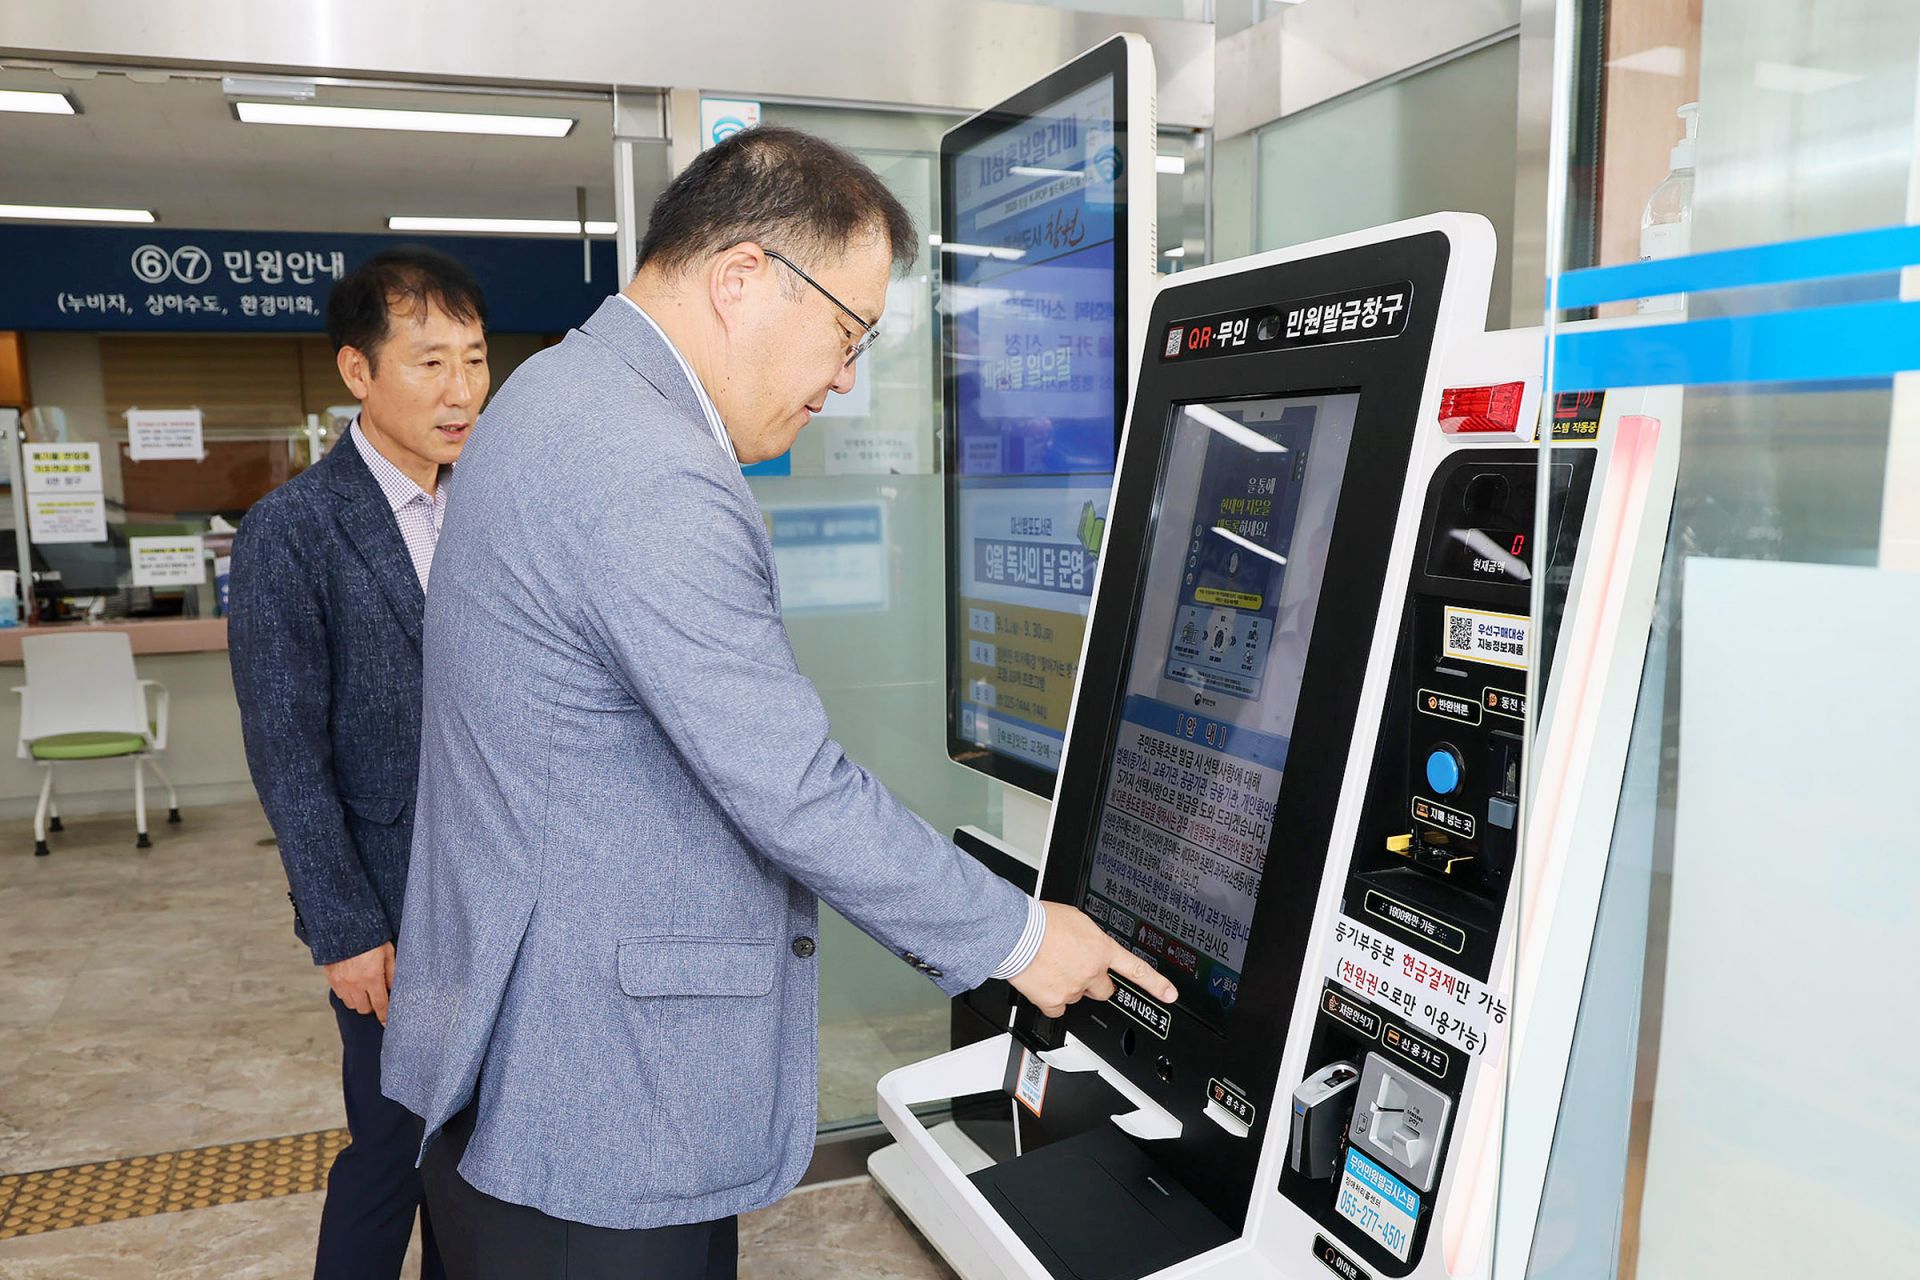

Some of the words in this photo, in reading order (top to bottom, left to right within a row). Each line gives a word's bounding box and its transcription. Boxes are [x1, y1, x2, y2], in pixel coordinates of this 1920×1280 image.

[224, 250, 345, 284] 민원안내
[58, 293, 133, 315] (누비자,
[145, 294, 228, 315] 상하수도,
[1286, 293, 1403, 337] 민원발급창구
[1572, 422, 1597, 433] 작동중
[1257, 476, 1275, 494] 통해
[1512, 535, 1524, 555] 0
[1007, 545, 1040, 585] 독서의
[1042, 548, 1055, 586] 달
[1059, 550, 1084, 590] 운영
[1473, 559, 1504, 573] 현재금액
[1477, 638, 1524, 656] 지능정보제품
[1478, 624, 1524, 641] 우선구매대상
[1438, 698, 1469, 716] 반환버튼
[1501, 696, 1518, 711] 동전
[1136, 735, 1178, 762] 주민등록초본
[1178, 748, 1194, 767] 발급
[1194, 753, 1202, 770] 시
[1202, 757, 1242, 785] 선택사항에
[1244, 771, 1260, 791] 대해
[1152, 761, 1180, 785] 교육기관,
[1180, 771, 1208, 796] 공공기관,
[1210, 782, 1240, 808] 금융기관,
[1118, 769, 1134, 788] 5가지
[1134, 776, 1176, 805] 선택사항으로
[1176, 792, 1198, 815] 발급을
[1198, 802, 1216, 822] 도와
[1216, 808, 1268, 844] 드리겠습니다.
[1176, 815, 1188, 833] 경우
[1240, 842, 1254, 862] 발급
[1464, 819, 1472, 831] 곳
[1118, 884, 1156, 921] 진행하시려면
[1158, 907, 1178, 933] 확인을
[1180, 919, 1196, 942] 눌러
[1196, 928, 1230, 962] 주십시오.
[1182, 894, 1206, 921] 창구에서
[1204, 907, 1218, 929] 교부
[1420, 919, 1436, 934] 가능
[1335, 921, 1395, 967] 등기부등본
[1402, 953, 1471, 1005] 현금결제만
[1478, 991, 1507, 1024] 가능
[1117, 988, 1136, 1010] 증명서
[1137, 1001, 1158, 1025] 나오는
[1159, 1015, 1166, 1031] 곳
[1336, 957, 1417, 1017] (천원권으로만
[1424, 1004, 1488, 1056] 이용가능)
[1338, 1004, 1373, 1031] 지문인식기
[1401, 1038, 1441, 1068] 신용카드
[1226, 1094, 1247, 1116] 영수증
[1349, 1156, 1415, 1210] 무인민원발급시스템
[1340, 1190, 1405, 1252] 055-277-4501
